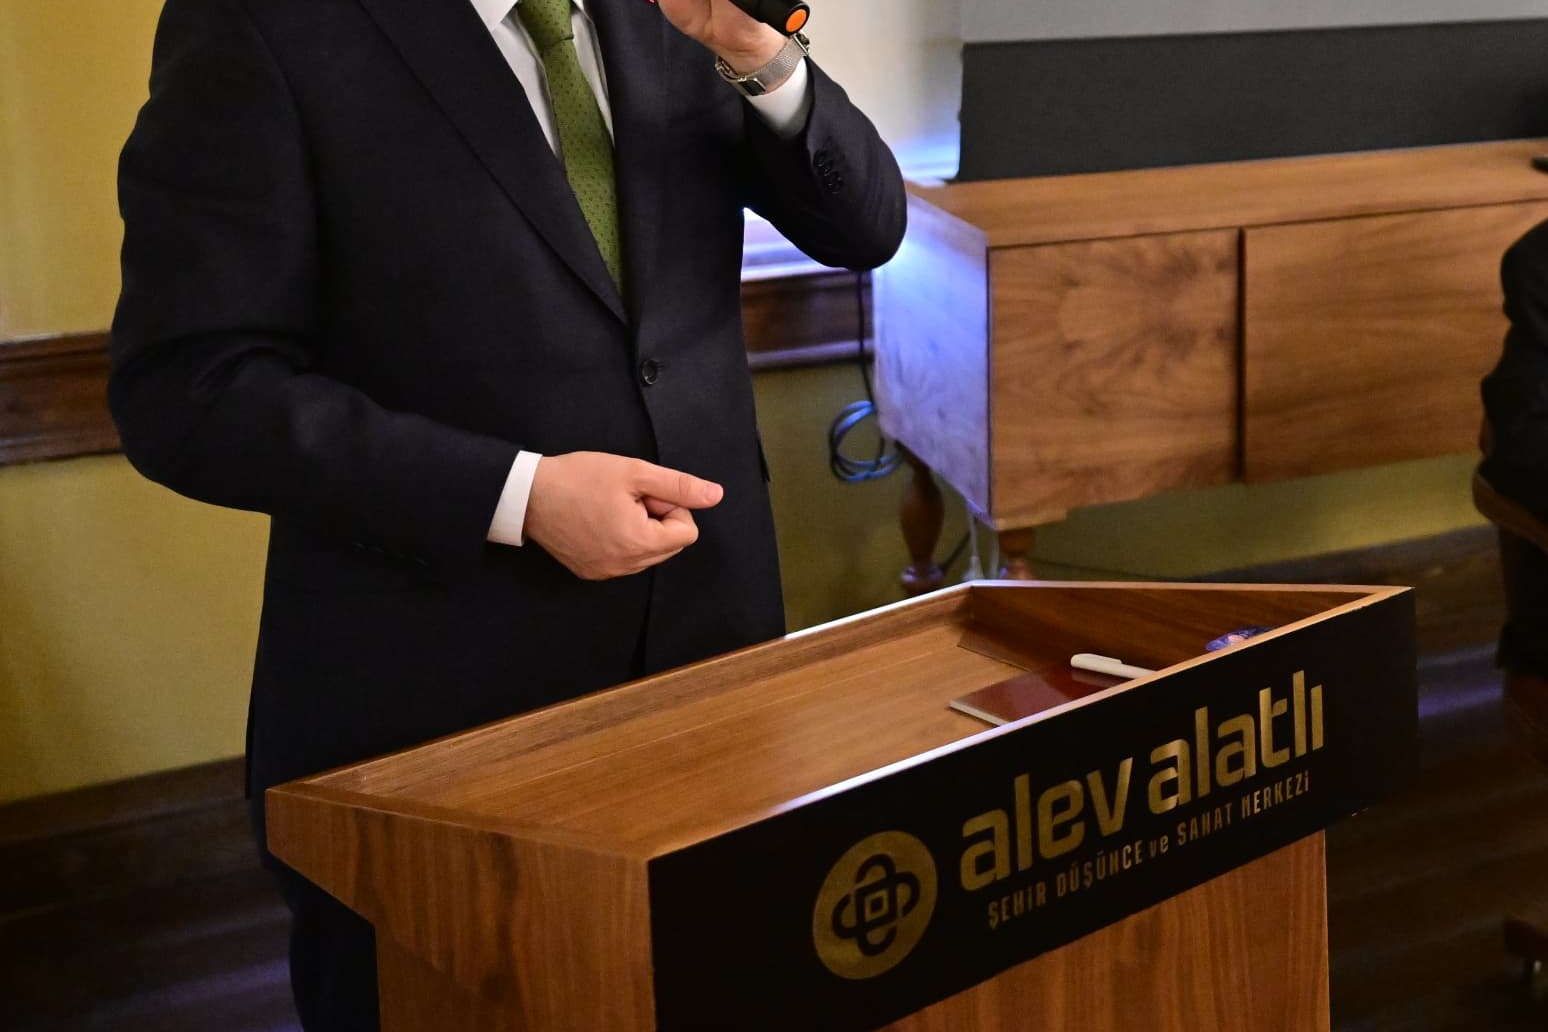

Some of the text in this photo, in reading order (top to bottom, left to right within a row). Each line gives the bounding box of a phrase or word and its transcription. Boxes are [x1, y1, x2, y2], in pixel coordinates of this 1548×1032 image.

[960, 670, 1324, 892] alev alatlı
[1056, 839, 1143, 898] DÜŞÜNCE
[1149, 834, 1169, 858] ve
[1177, 802, 1233, 847] SANAT
